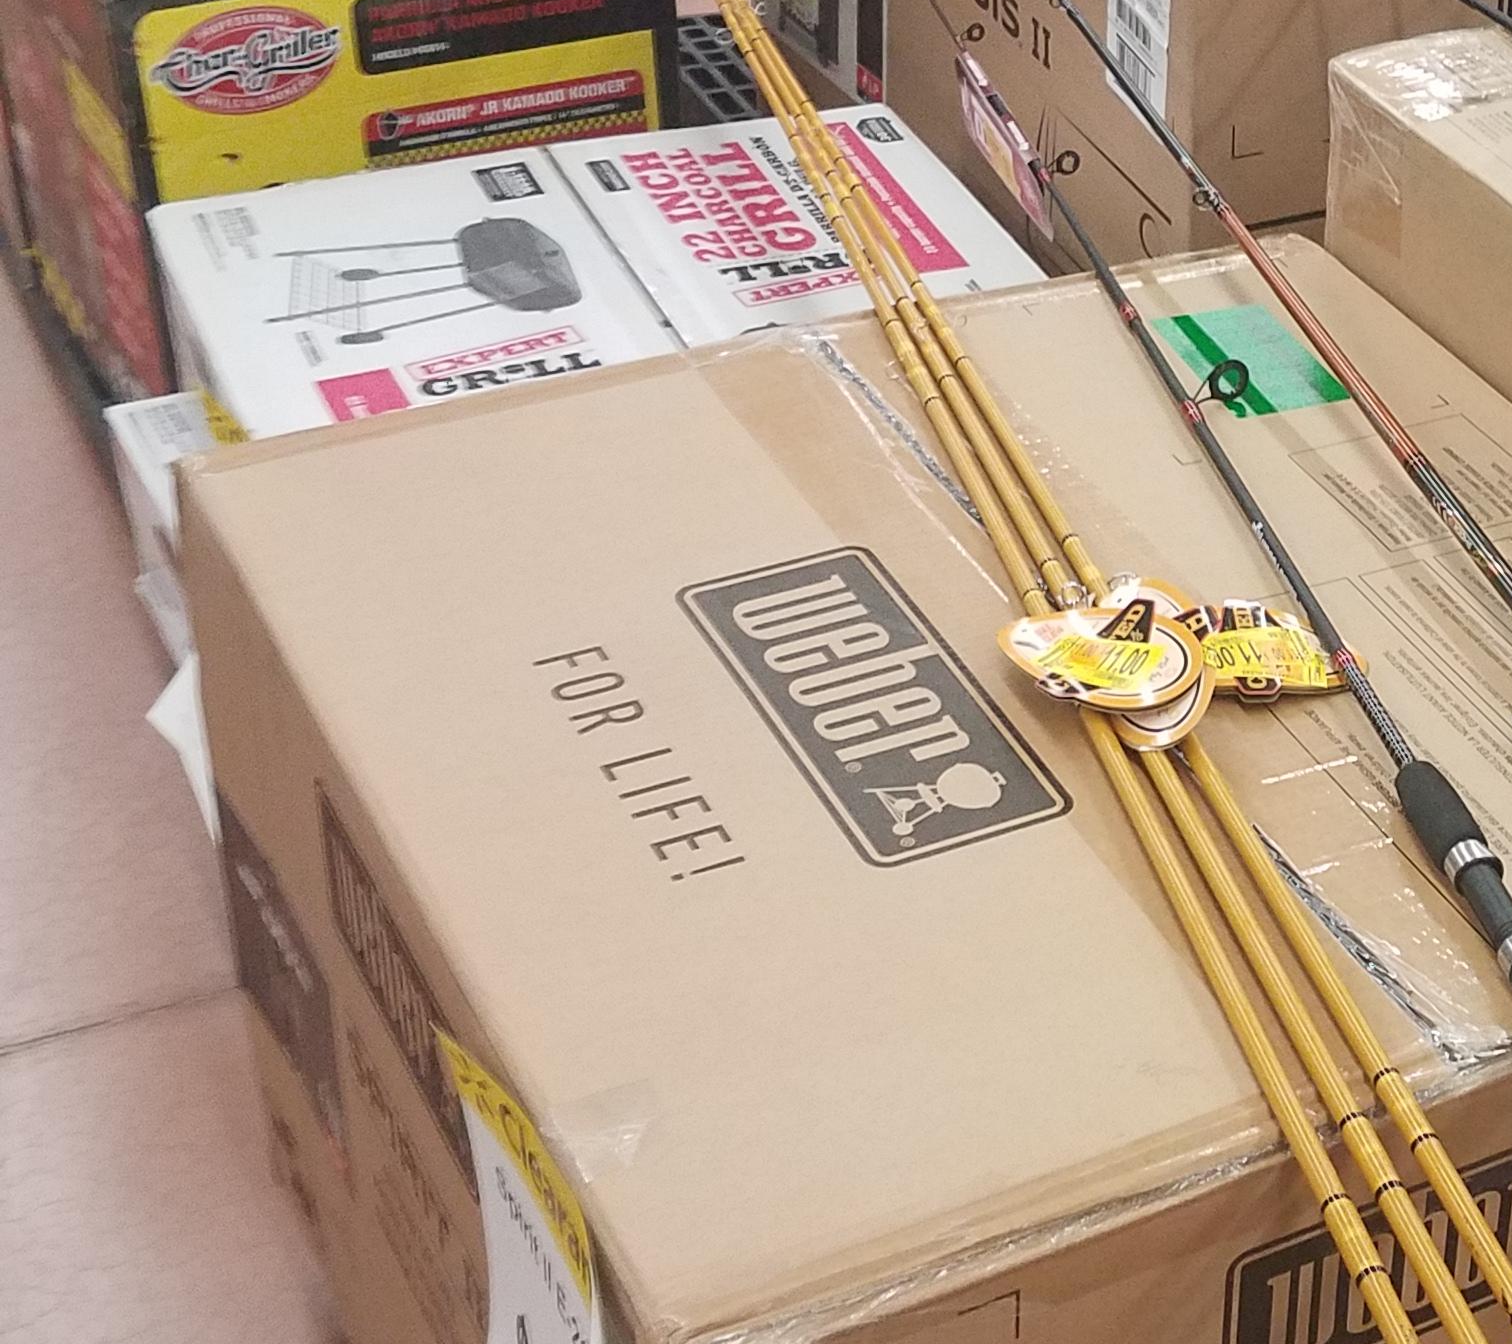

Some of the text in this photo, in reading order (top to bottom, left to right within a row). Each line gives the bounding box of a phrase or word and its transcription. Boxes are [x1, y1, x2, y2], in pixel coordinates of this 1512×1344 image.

[620, 151, 737, 262] 22 INCH
[668, 148, 768, 258] CHARCOAL
[701, 141, 817, 252] GRILL
[731, 573, 971, 764] weber
[532, 644, 747, 883] FOR LIFE!
